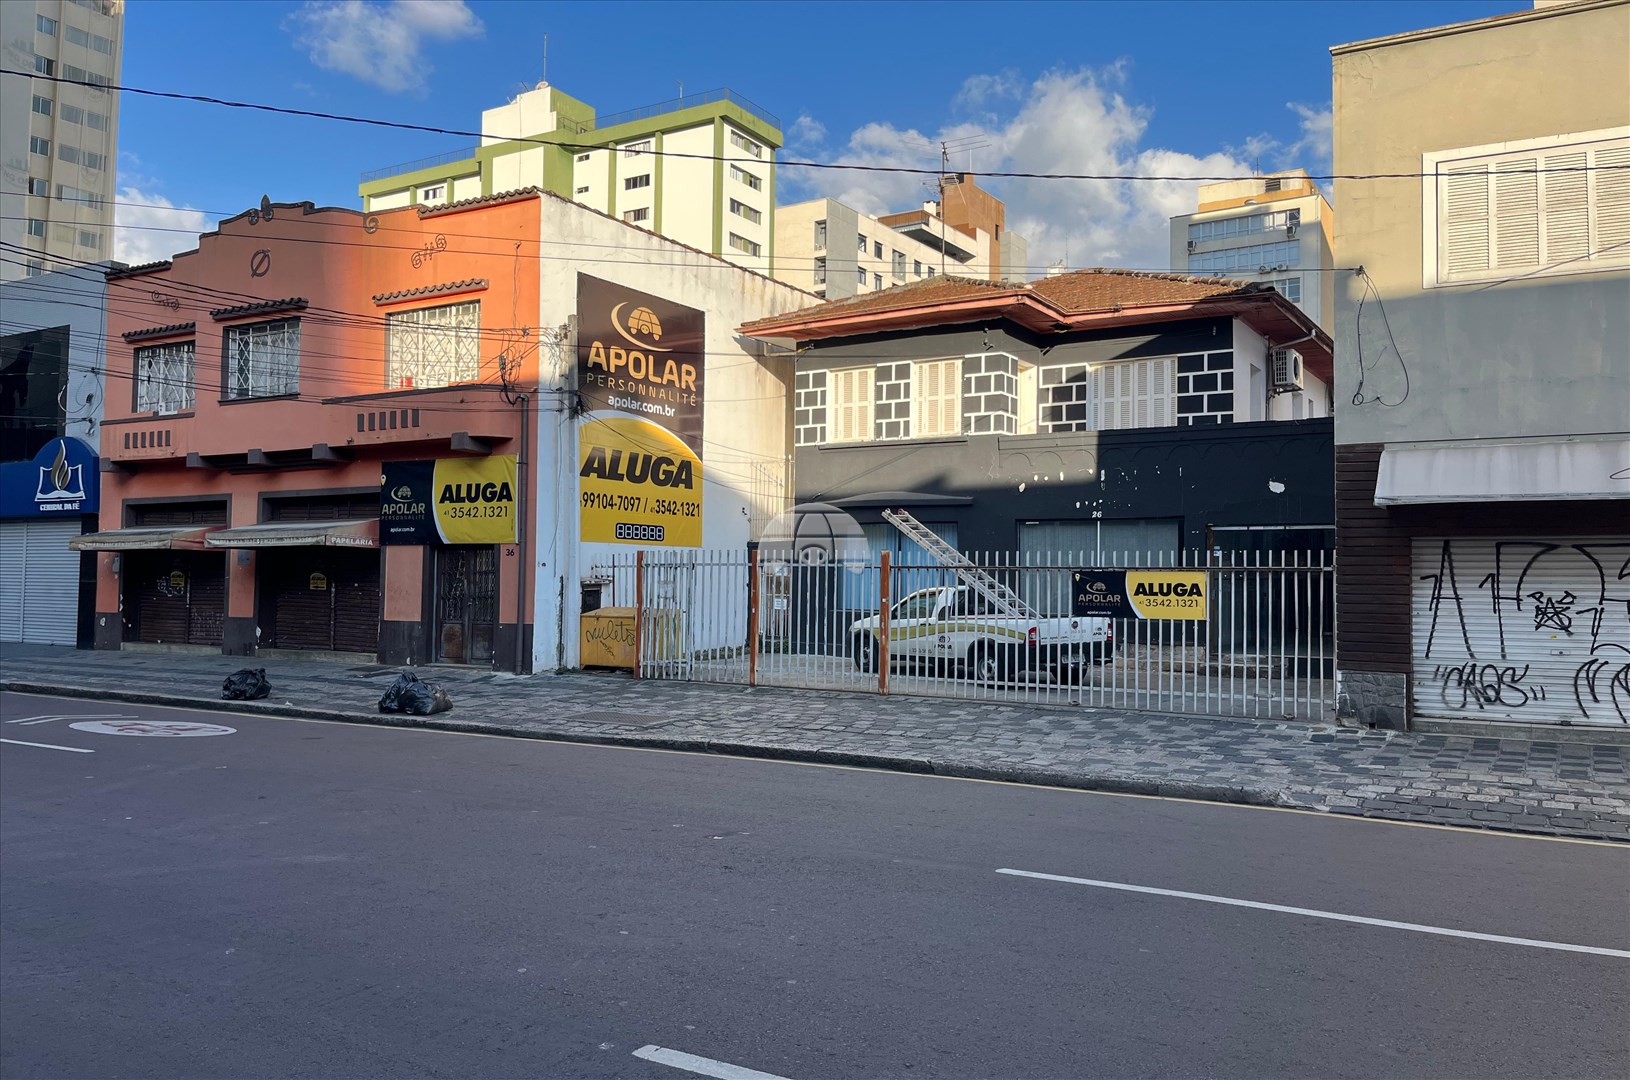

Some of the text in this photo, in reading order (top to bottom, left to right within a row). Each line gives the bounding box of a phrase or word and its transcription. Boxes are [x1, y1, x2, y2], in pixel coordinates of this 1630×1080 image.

[587, 340, 697, 392] APOLAR
[586, 373, 697, 407] PERSONNALITÉ
[608, 395, 676, 417] apolar.com.br
[580, 446, 693, 490] ALUGA
[439, 482, 513, 504] ALUGA
[381, 503, 426, 515] APOLAR
[582, 491, 641, 512] 99104-7097
[655, 499, 700, 517] 3542-1321
[450, 506, 509, 518] 3542.1321
[1092, 510, 1102, 518] 26
[505, 548, 515, 557] 36
[1134, 582, 1203, 597] ALUGA
[1078, 593, 1121, 603] APOLAR
[1145, 599, 1199, 608] 3542.1321
